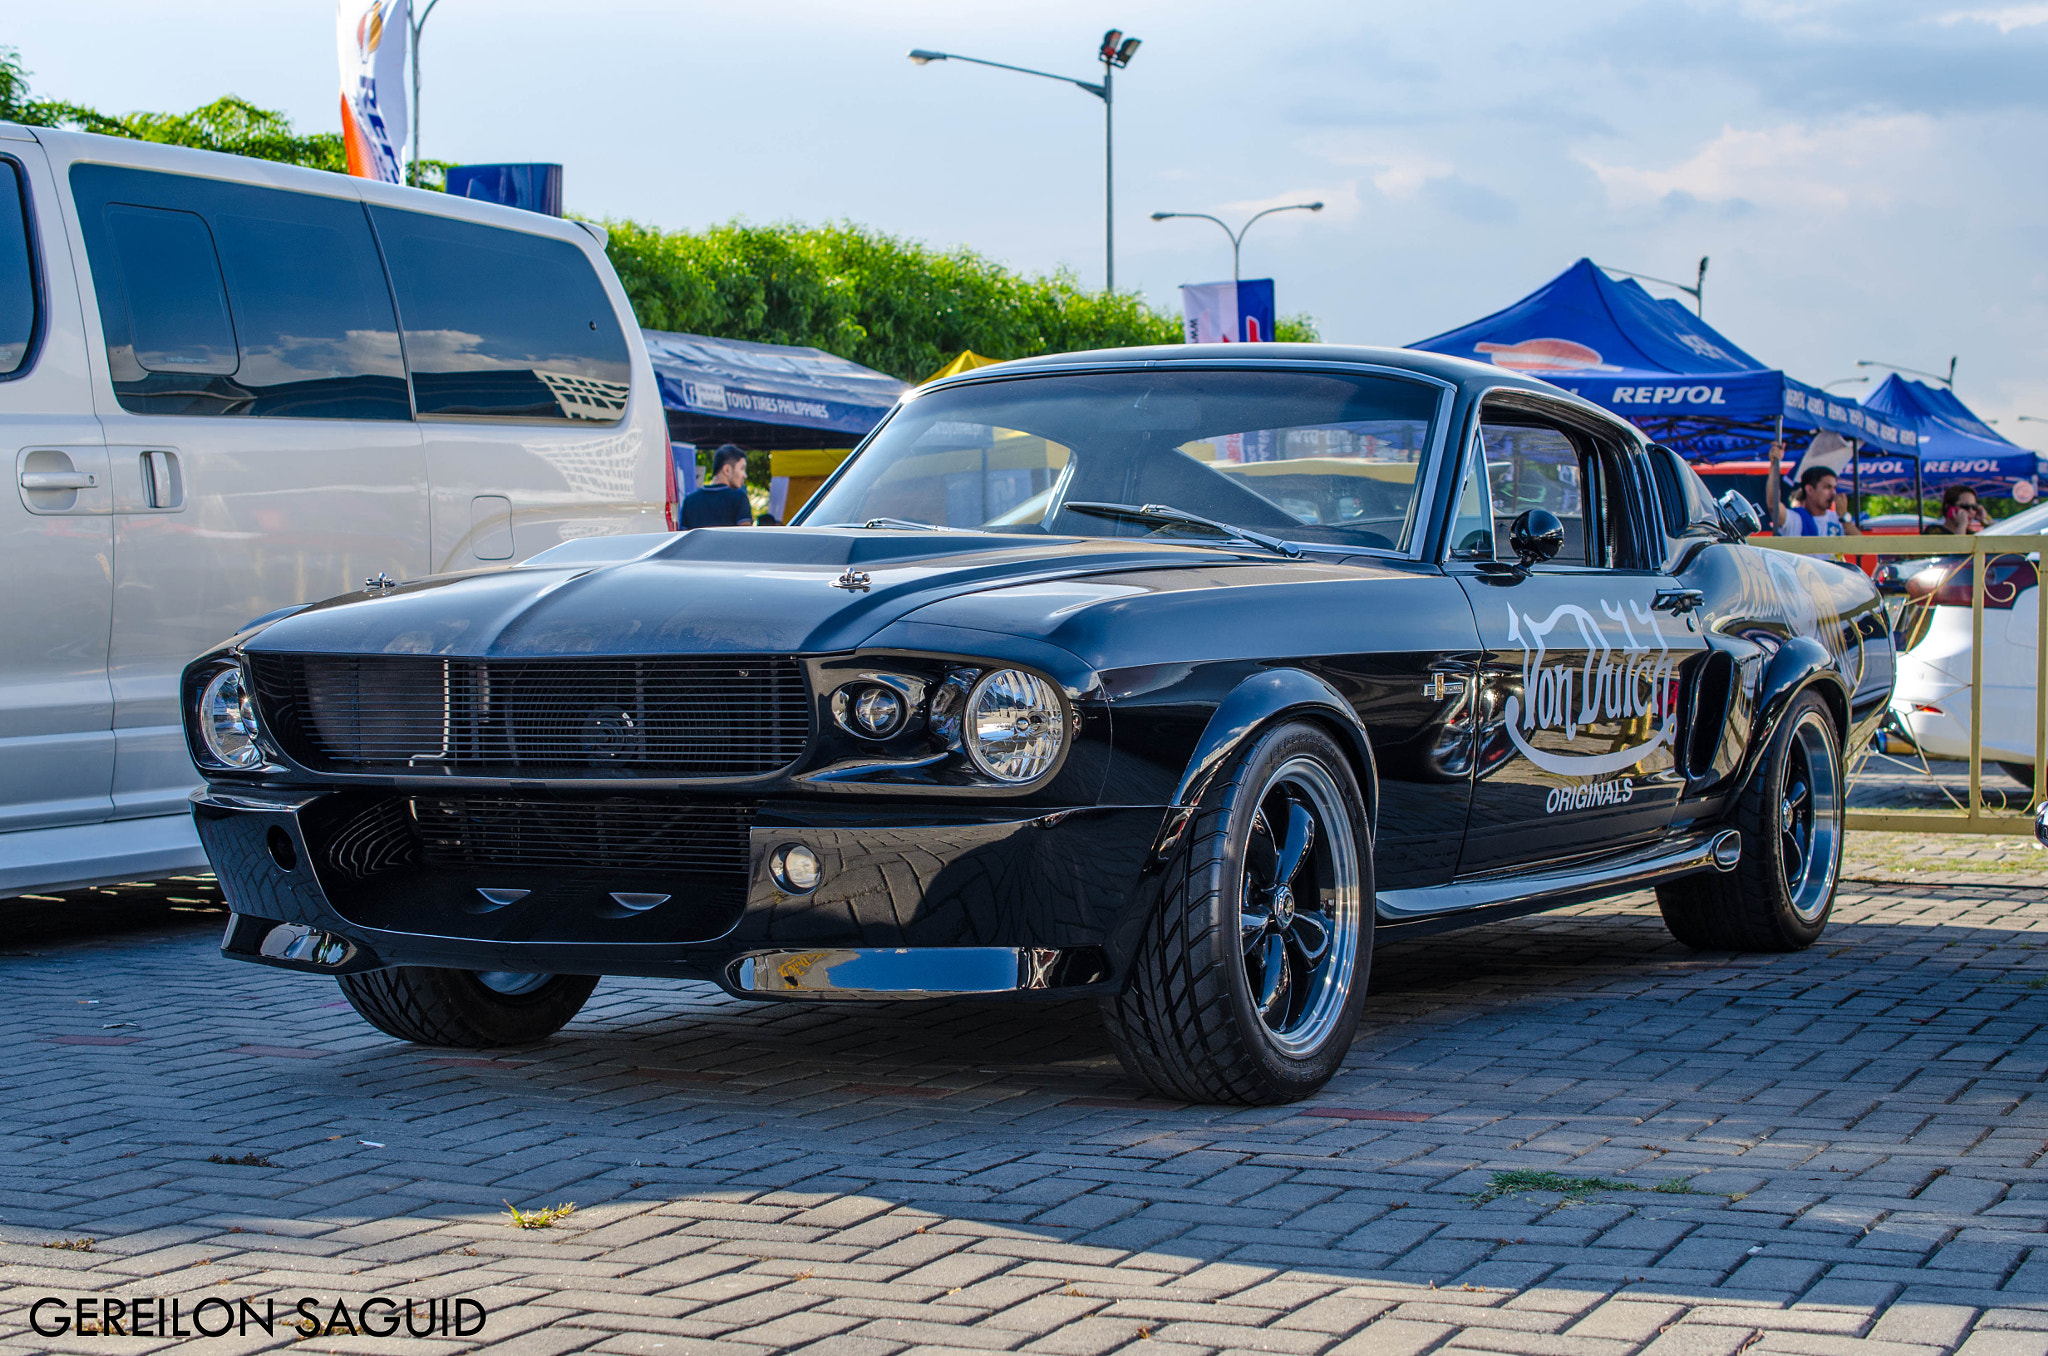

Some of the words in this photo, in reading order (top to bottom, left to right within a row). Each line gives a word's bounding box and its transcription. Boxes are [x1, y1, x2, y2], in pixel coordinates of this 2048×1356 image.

[725, 391, 751, 410] TOYO
[751, 394, 778, 413] TIRES
[777, 398, 829, 419] PHILIPPINES
[1612, 385, 1726, 404] REPSOL
[1842, 460, 1905, 475] EPSOL
[1923, 459, 2001, 473] REPSOL
[1546, 777, 1634, 814] ORIGINALS
